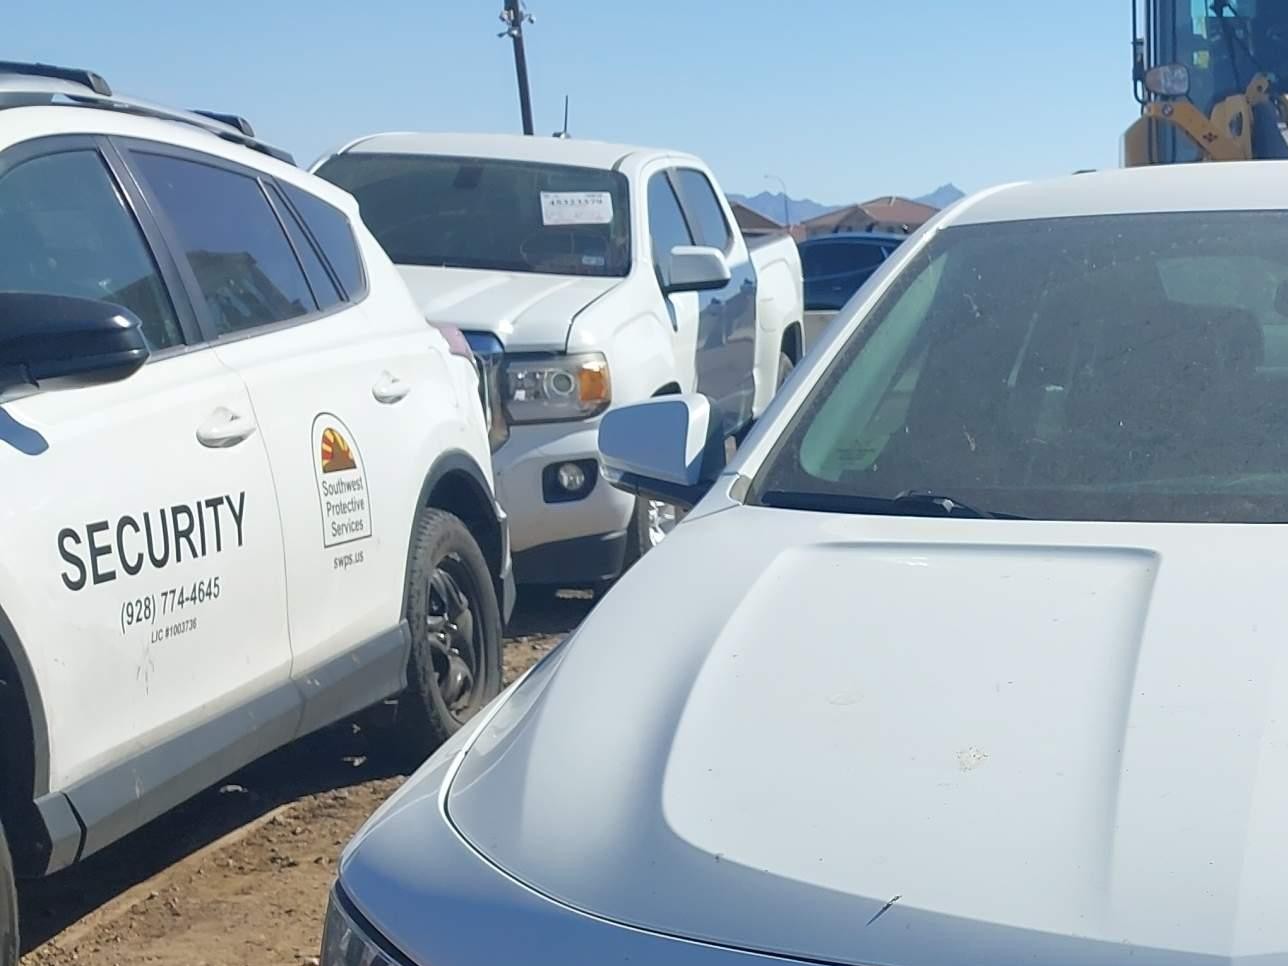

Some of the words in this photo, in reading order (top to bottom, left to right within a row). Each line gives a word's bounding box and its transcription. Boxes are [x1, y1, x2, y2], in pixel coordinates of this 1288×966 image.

[322, 476, 363, 497] Southwest
[326, 495, 365, 517] Protective
[331, 518, 364, 537] Services
[57, 491, 246, 591] SECURITY
[333, 550, 364, 569] swps.us
[121, 594, 156, 634] (928)
[161, 576, 220, 616] 774-4645
[151, 628, 164, 644] LIC
